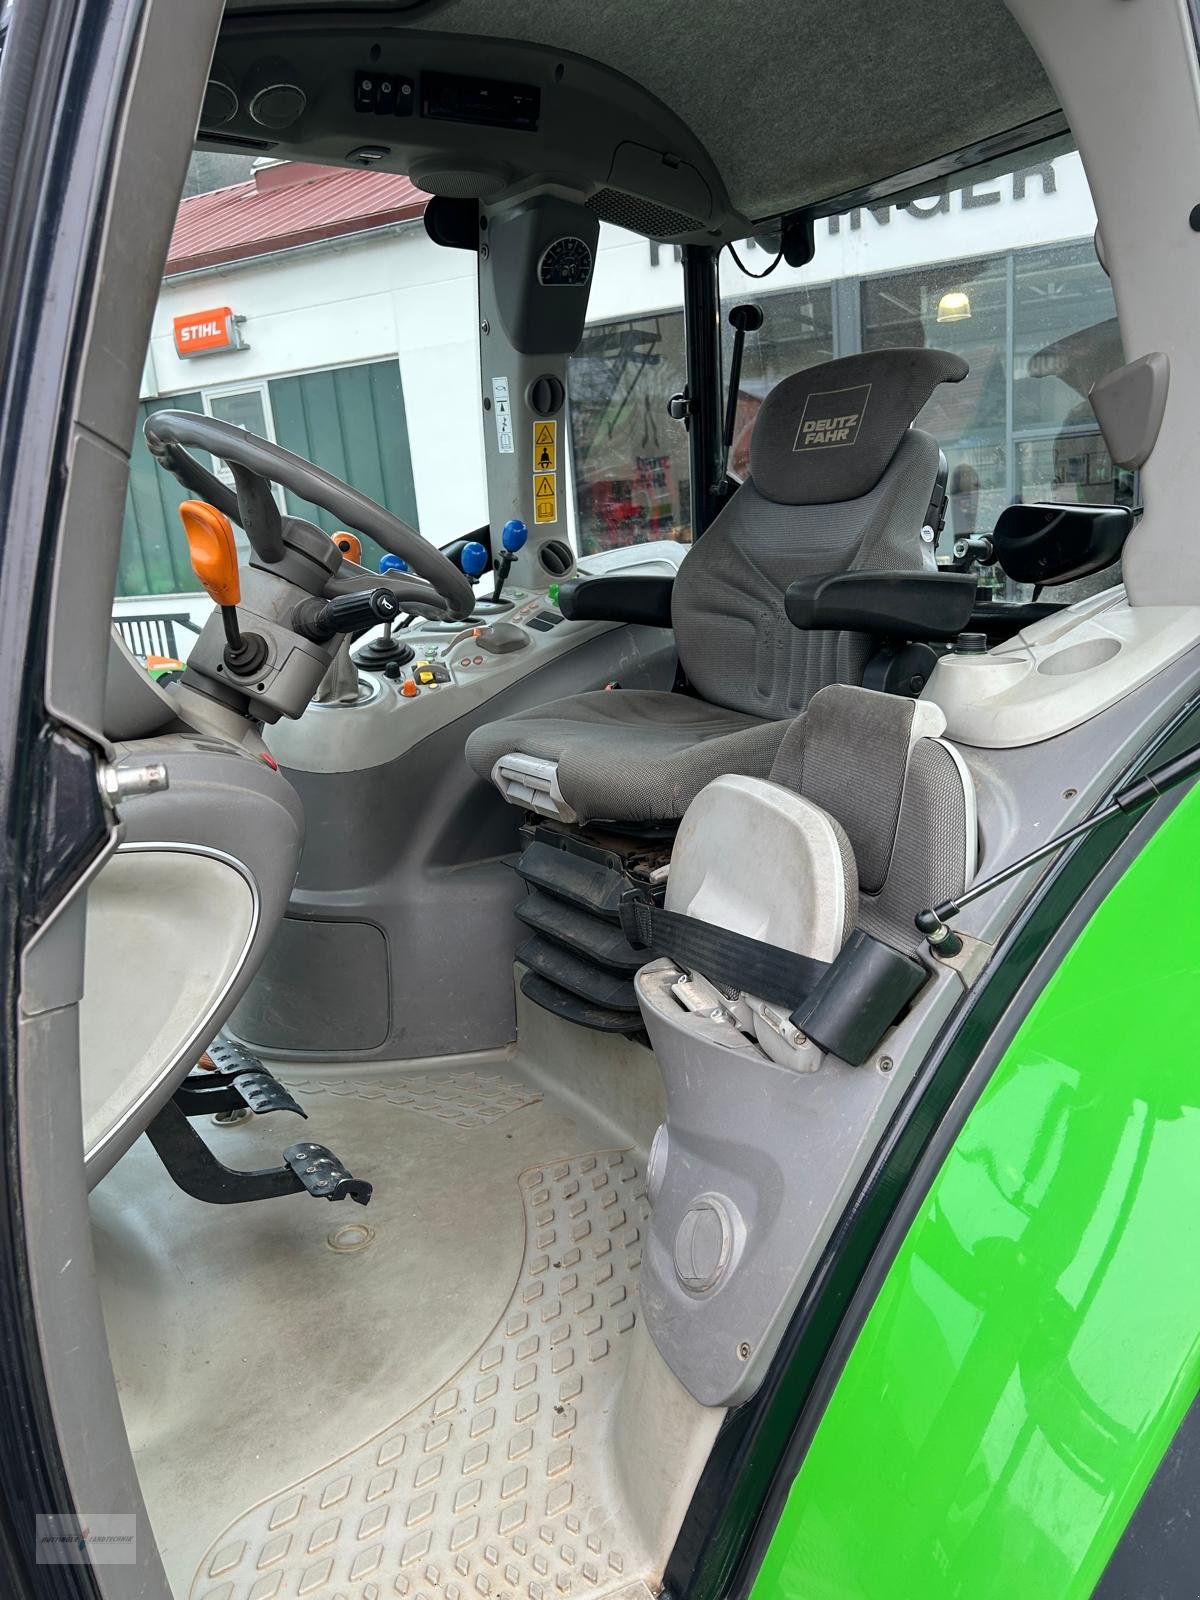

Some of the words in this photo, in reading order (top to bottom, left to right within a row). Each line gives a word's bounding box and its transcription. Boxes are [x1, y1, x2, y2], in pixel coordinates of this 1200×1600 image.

[181, 321, 221, 341] STIHL
[803, 414, 859, 433] DEUTZ
[804, 428, 850, 445] FAHR
